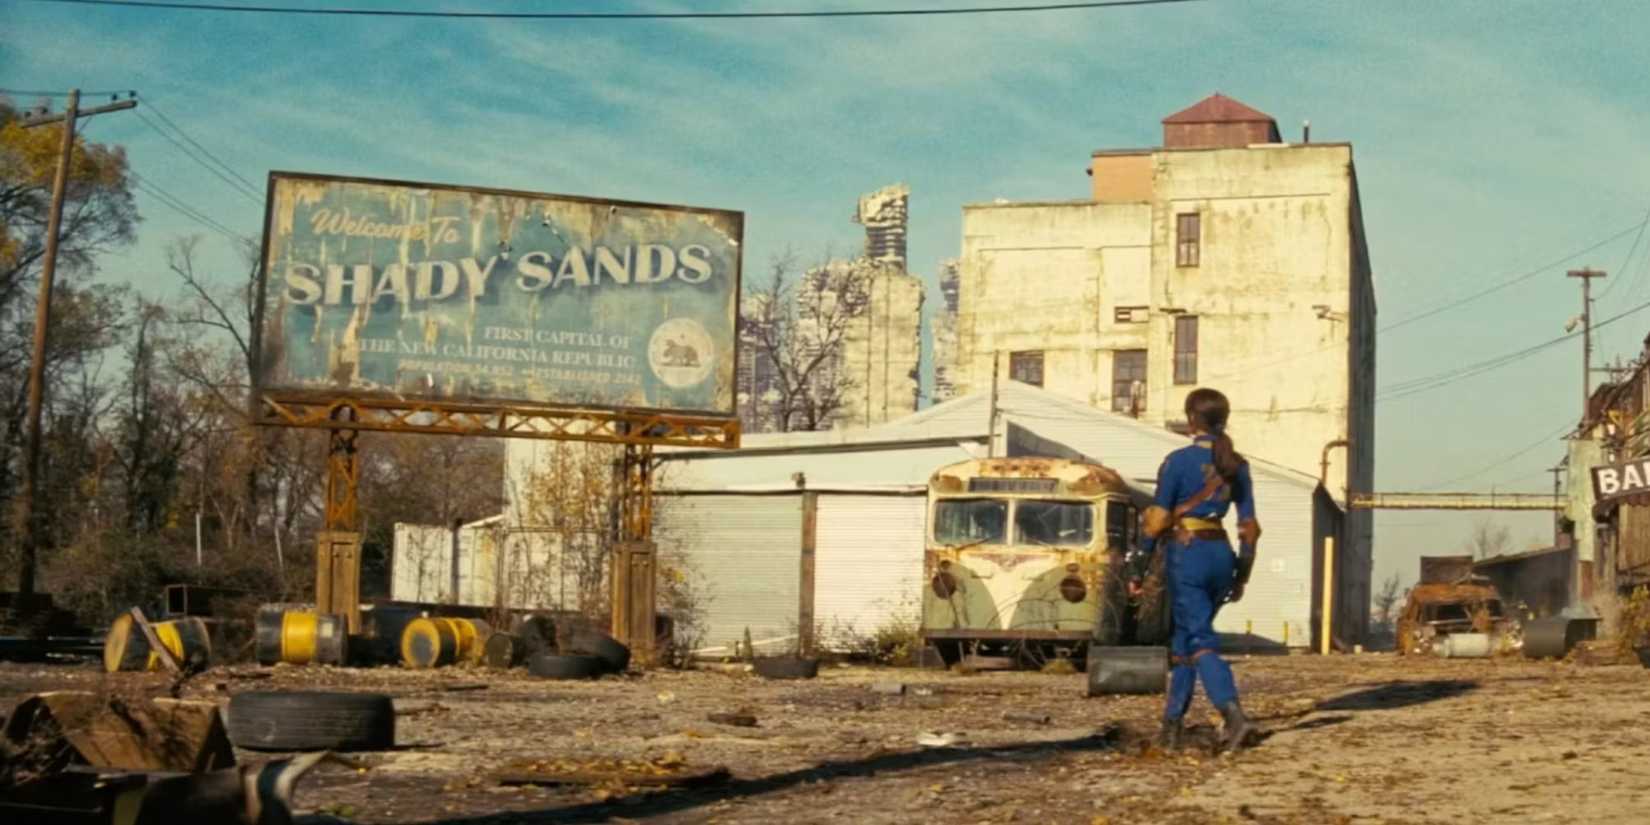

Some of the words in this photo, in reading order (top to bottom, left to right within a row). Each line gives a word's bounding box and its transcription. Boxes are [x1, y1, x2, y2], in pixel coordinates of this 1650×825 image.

[311, 206, 428, 240] Welcome
[431, 216, 462, 245] To
[284, 255, 499, 305] SHADY
[516, 243, 713, 292] SANDS
[360, 338, 397, 353] THE
[398, 339, 442, 355] NEW
[443, 343, 548, 363] CALIFORNIA
[552, 351, 636, 369] REPUBLIC
[484, 326, 531, 342] FIRST
[535, 329, 604, 347] CAPITAL
[609, 334, 633, 349] OF
[1597, 461, 1650, 495] BA
